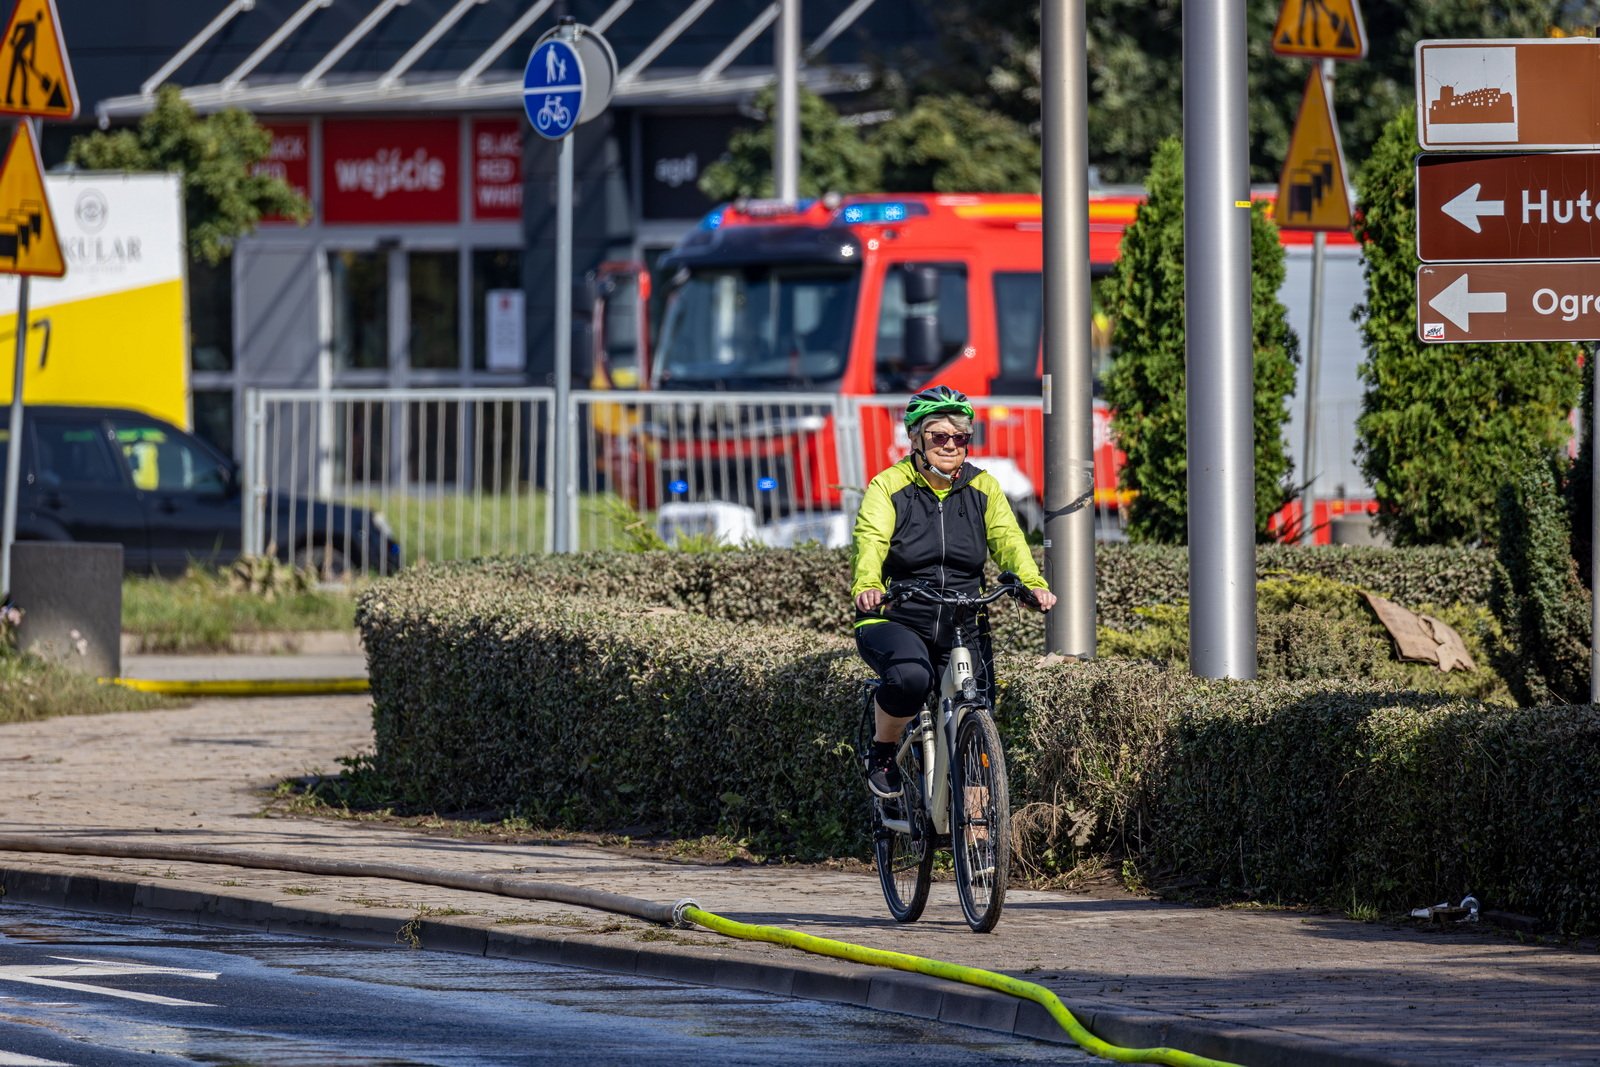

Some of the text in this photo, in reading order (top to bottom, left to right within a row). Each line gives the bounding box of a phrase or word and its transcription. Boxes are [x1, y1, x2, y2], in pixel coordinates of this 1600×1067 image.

[477, 132, 522, 157] BLAC
[335, 148, 446, 199] wejście
[61, 236, 142, 263] KULAR
